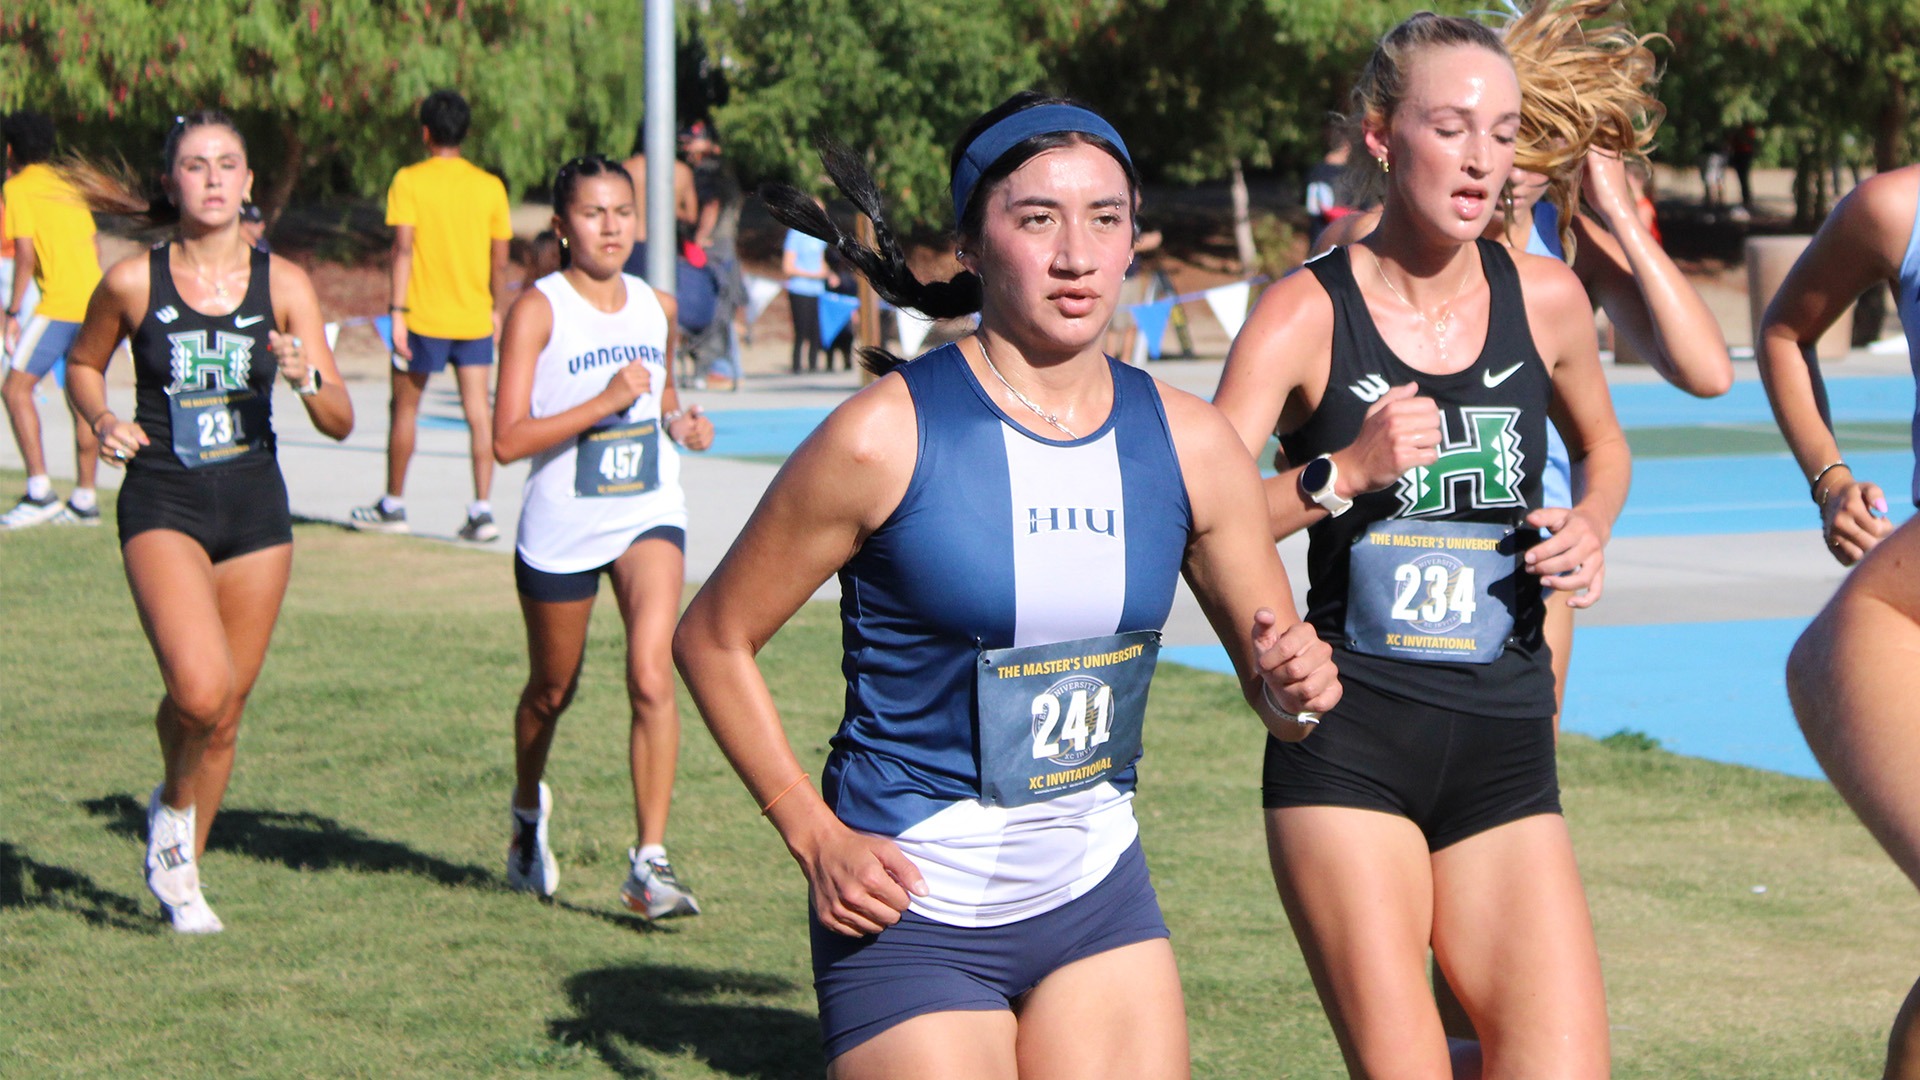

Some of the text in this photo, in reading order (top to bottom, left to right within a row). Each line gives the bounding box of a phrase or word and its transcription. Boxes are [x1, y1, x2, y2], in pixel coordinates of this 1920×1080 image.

[568, 345, 666, 375] VANGUAR
[197, 409, 246, 447] 231
[599, 443, 643, 480] 457
[1027, 507, 1118, 538] HIU
[1370, 533, 1501, 551] THE MASTER'S UNIVERSIT
[1391, 563, 1477, 624] 234
[1386, 634, 1477, 650] XC INVITATIONAL
[998, 643, 1144, 680] THE MASTER'S UNIVERSITY
[1052, 681, 1099, 698] NIVERSITY
[1031, 685, 1111, 760] 241
[1029, 775, 1045, 790] XC
[1046, 757, 1112, 787] INVITATIONAL
